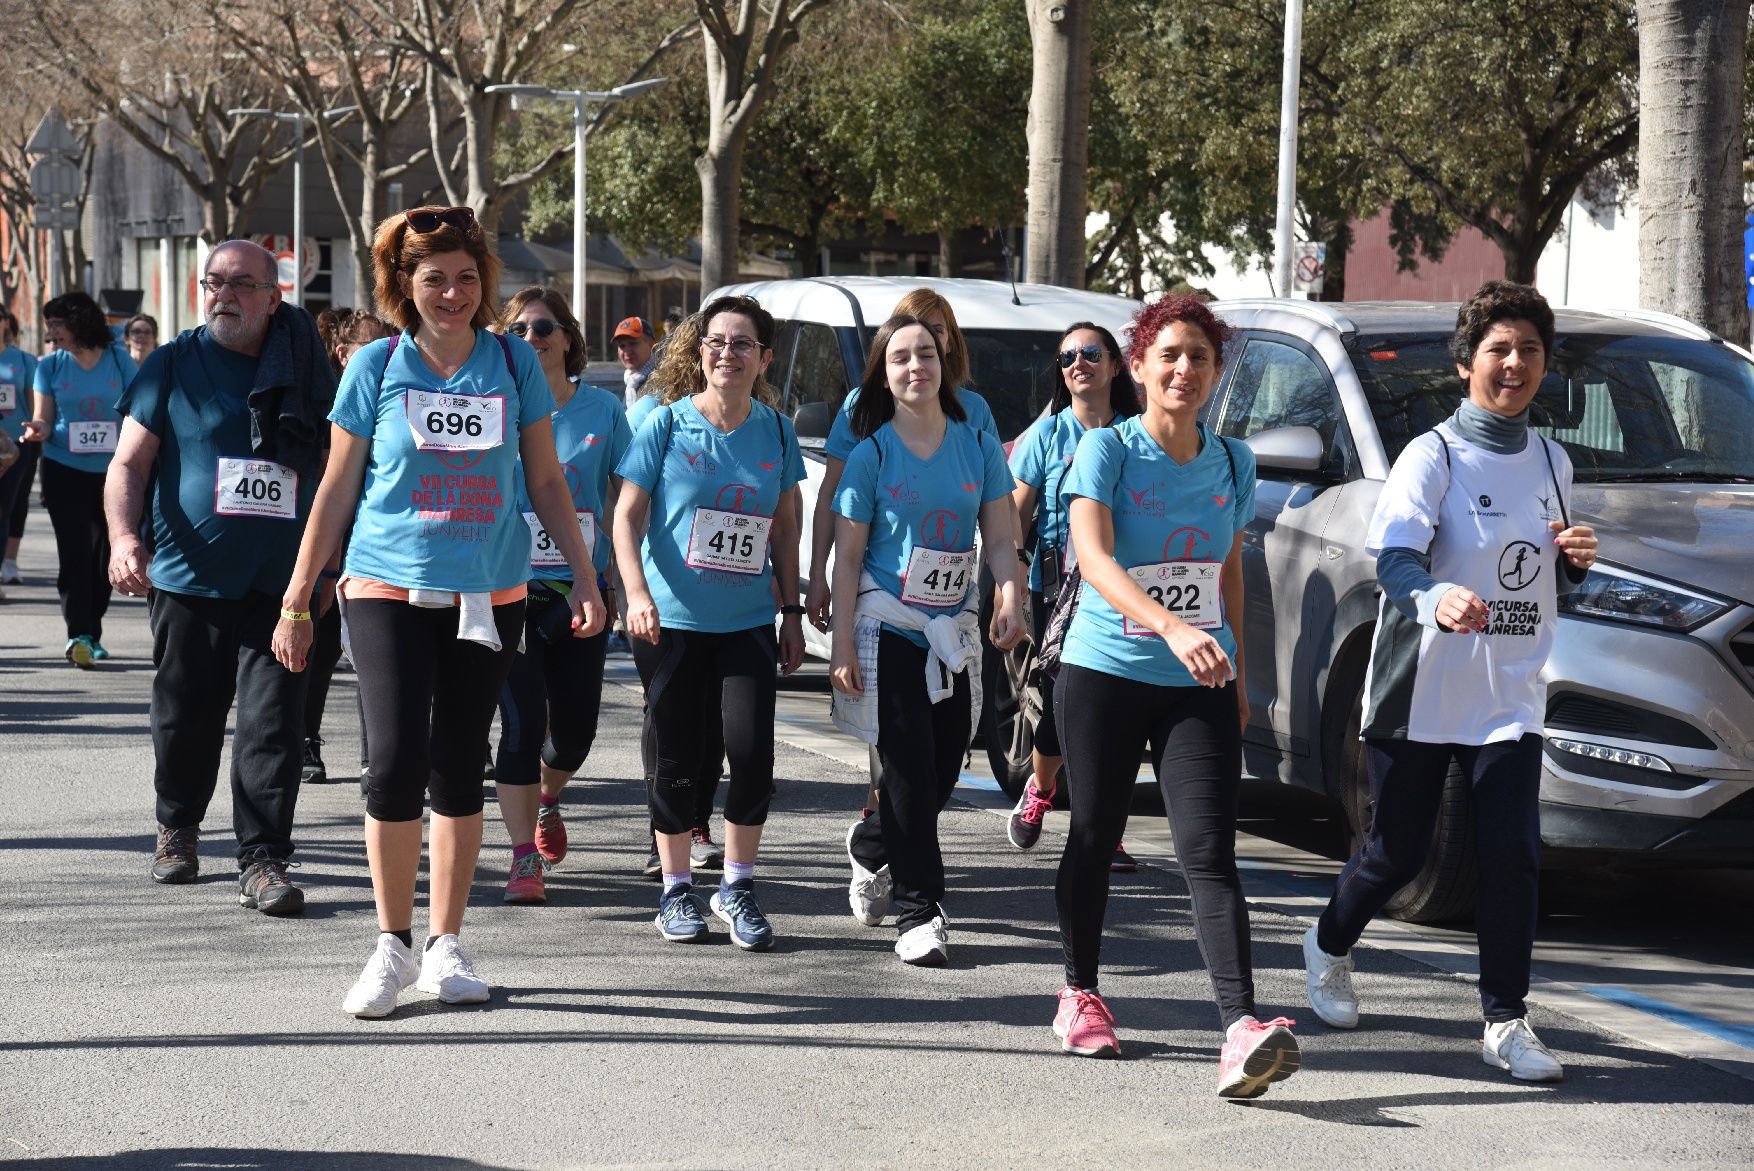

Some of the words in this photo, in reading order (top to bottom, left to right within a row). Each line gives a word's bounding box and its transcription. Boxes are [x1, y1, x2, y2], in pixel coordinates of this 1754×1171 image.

[427, 411, 482, 437] 696
[79, 431, 107, 444] 347
[235, 477, 281, 502] 406
[419, 474, 441, 489] VII
[444, 474, 497, 490] CURSA
[412, 490, 433, 505] DE
[436, 491, 456, 506] LA
[460, 492, 504, 507] DONA
[419, 506, 496, 523] MANRESA
[420, 523, 490, 541] JUNYENT
[708, 530, 754, 557] 415
[923, 569, 965, 591] 414
[1146, 584, 1201, 611] 322
